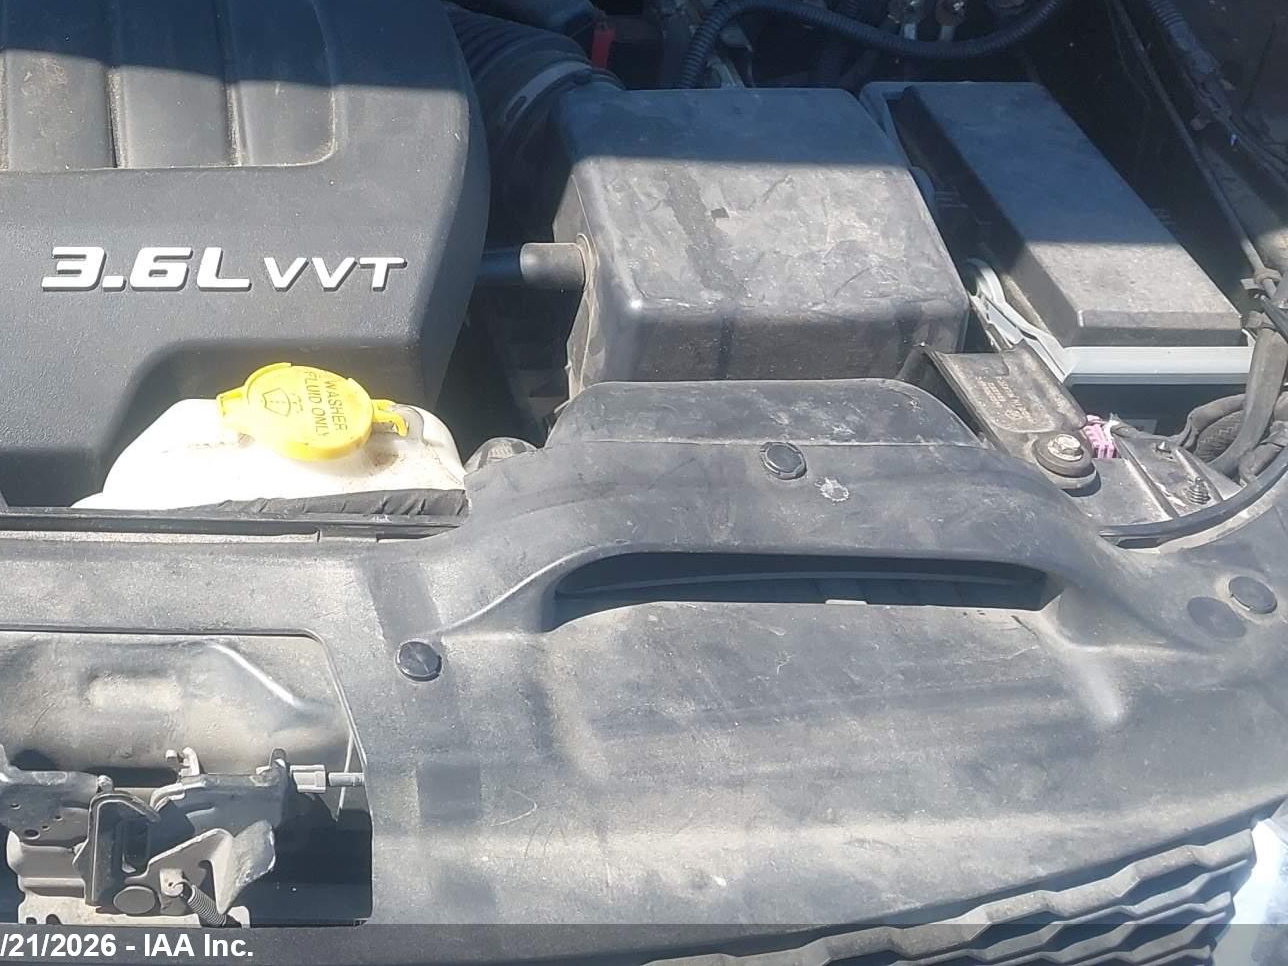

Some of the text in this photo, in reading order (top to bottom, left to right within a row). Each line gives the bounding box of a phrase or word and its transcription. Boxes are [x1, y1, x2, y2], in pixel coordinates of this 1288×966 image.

[41, 246, 408, 292] 3.6L VVT
[303, 370, 331, 437] FLUID ONLY
[323, 379, 348, 431] WASHER
